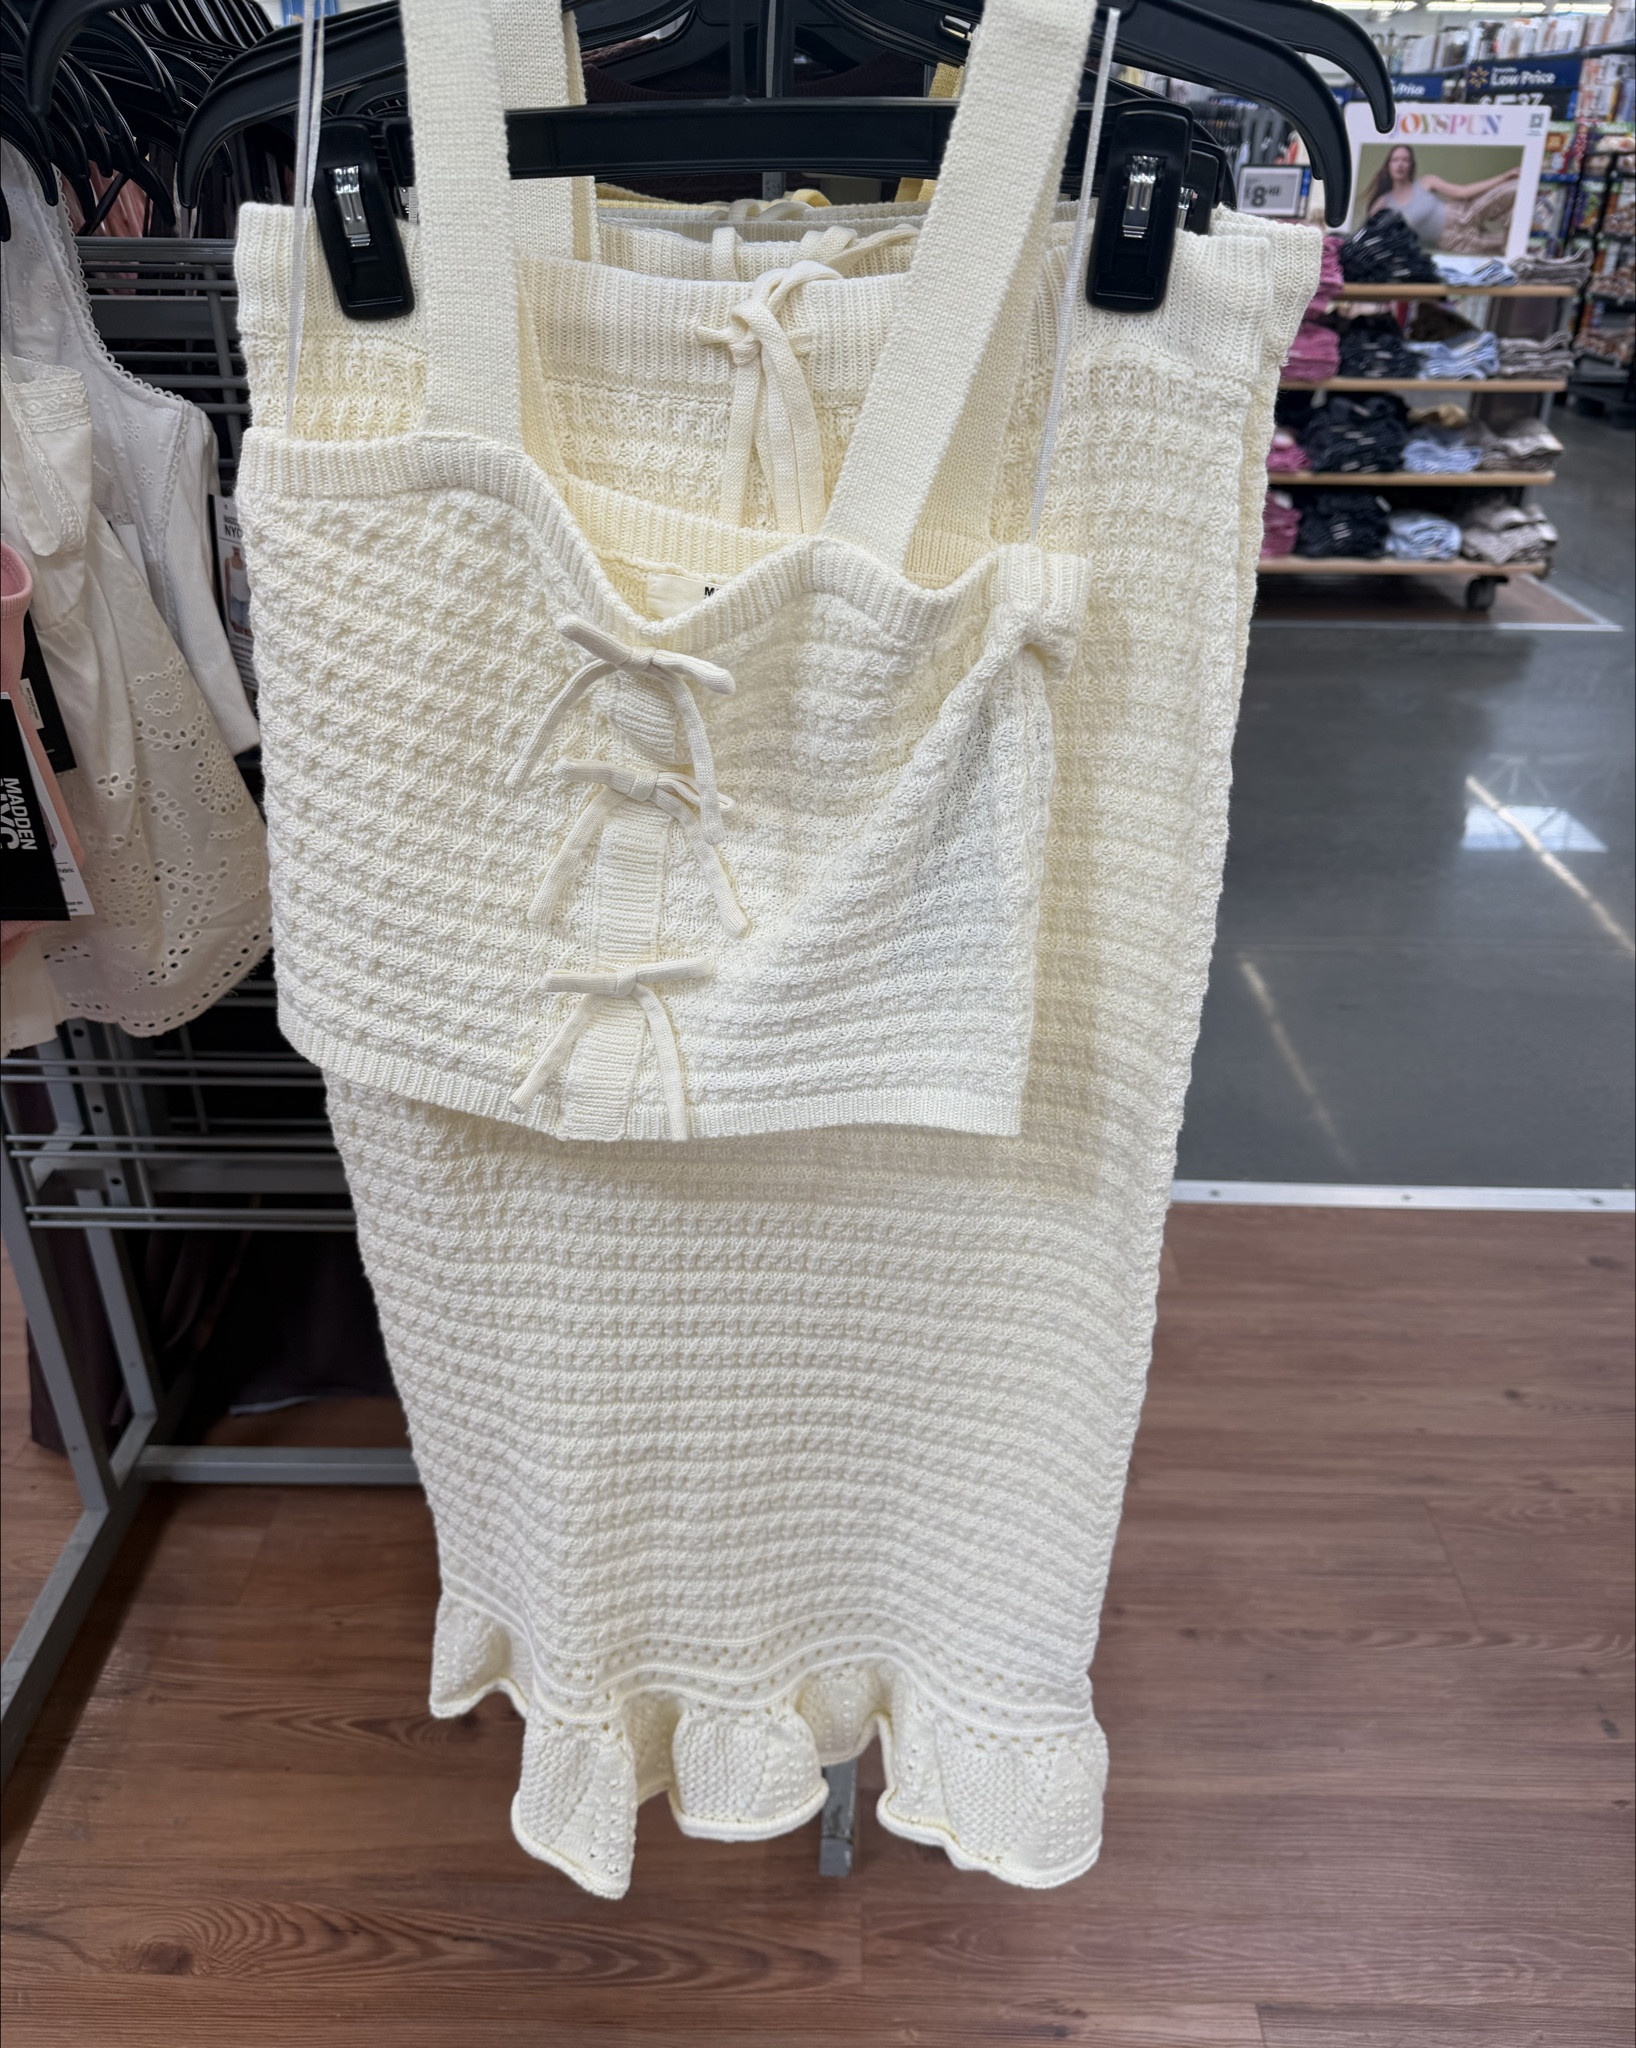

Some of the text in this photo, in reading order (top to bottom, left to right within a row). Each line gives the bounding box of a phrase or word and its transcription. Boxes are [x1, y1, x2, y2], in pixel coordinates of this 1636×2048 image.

[1520, 69, 1556, 86] Price
[1388, 112, 1503, 139] JOYSPUN
[3, 777, 38, 850] MADDEN
